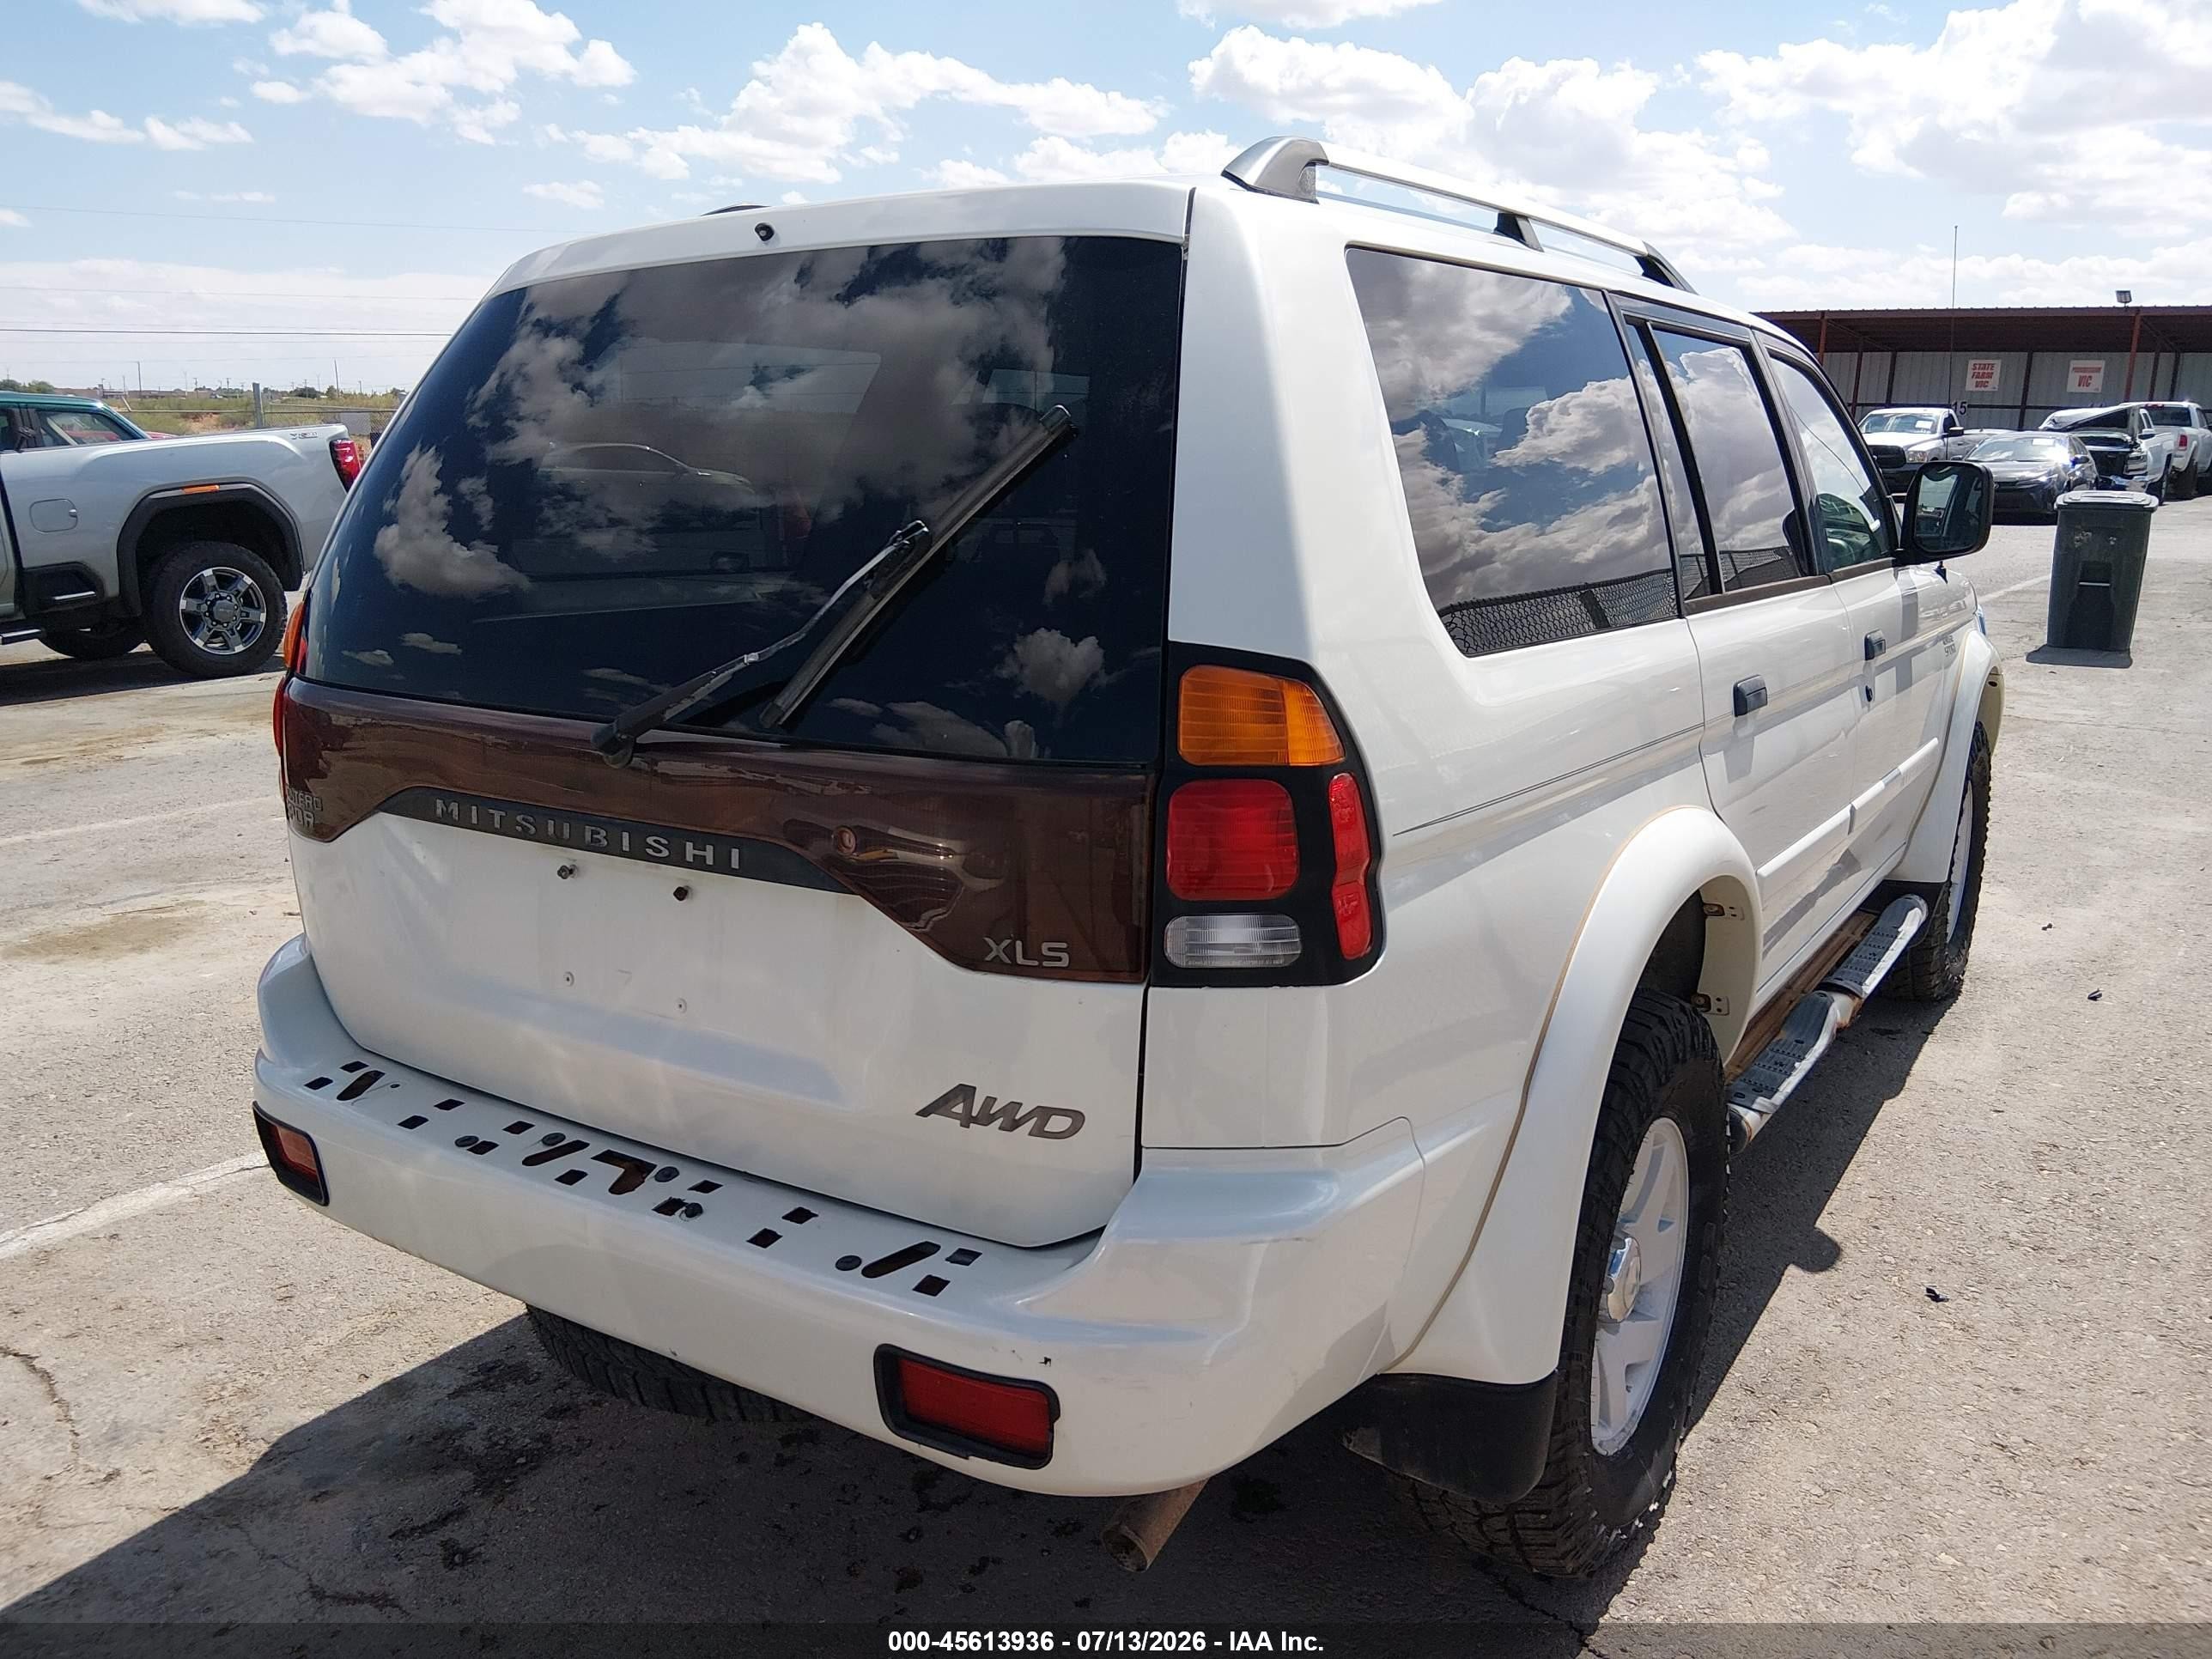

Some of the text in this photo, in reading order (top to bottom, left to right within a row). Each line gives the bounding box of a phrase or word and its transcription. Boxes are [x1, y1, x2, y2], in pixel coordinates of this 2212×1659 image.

[1972, 362, 1995, 371] STATE
[1972, 371, 1993, 380] FARM
[2078, 374, 2093, 387] VIC
[1952, 400, 1967, 416] 15
[435, 798, 740, 870] MITSUBISHI
[983, 937, 1070, 968] XLS
[915, 1083, 1086, 1140] AWD
